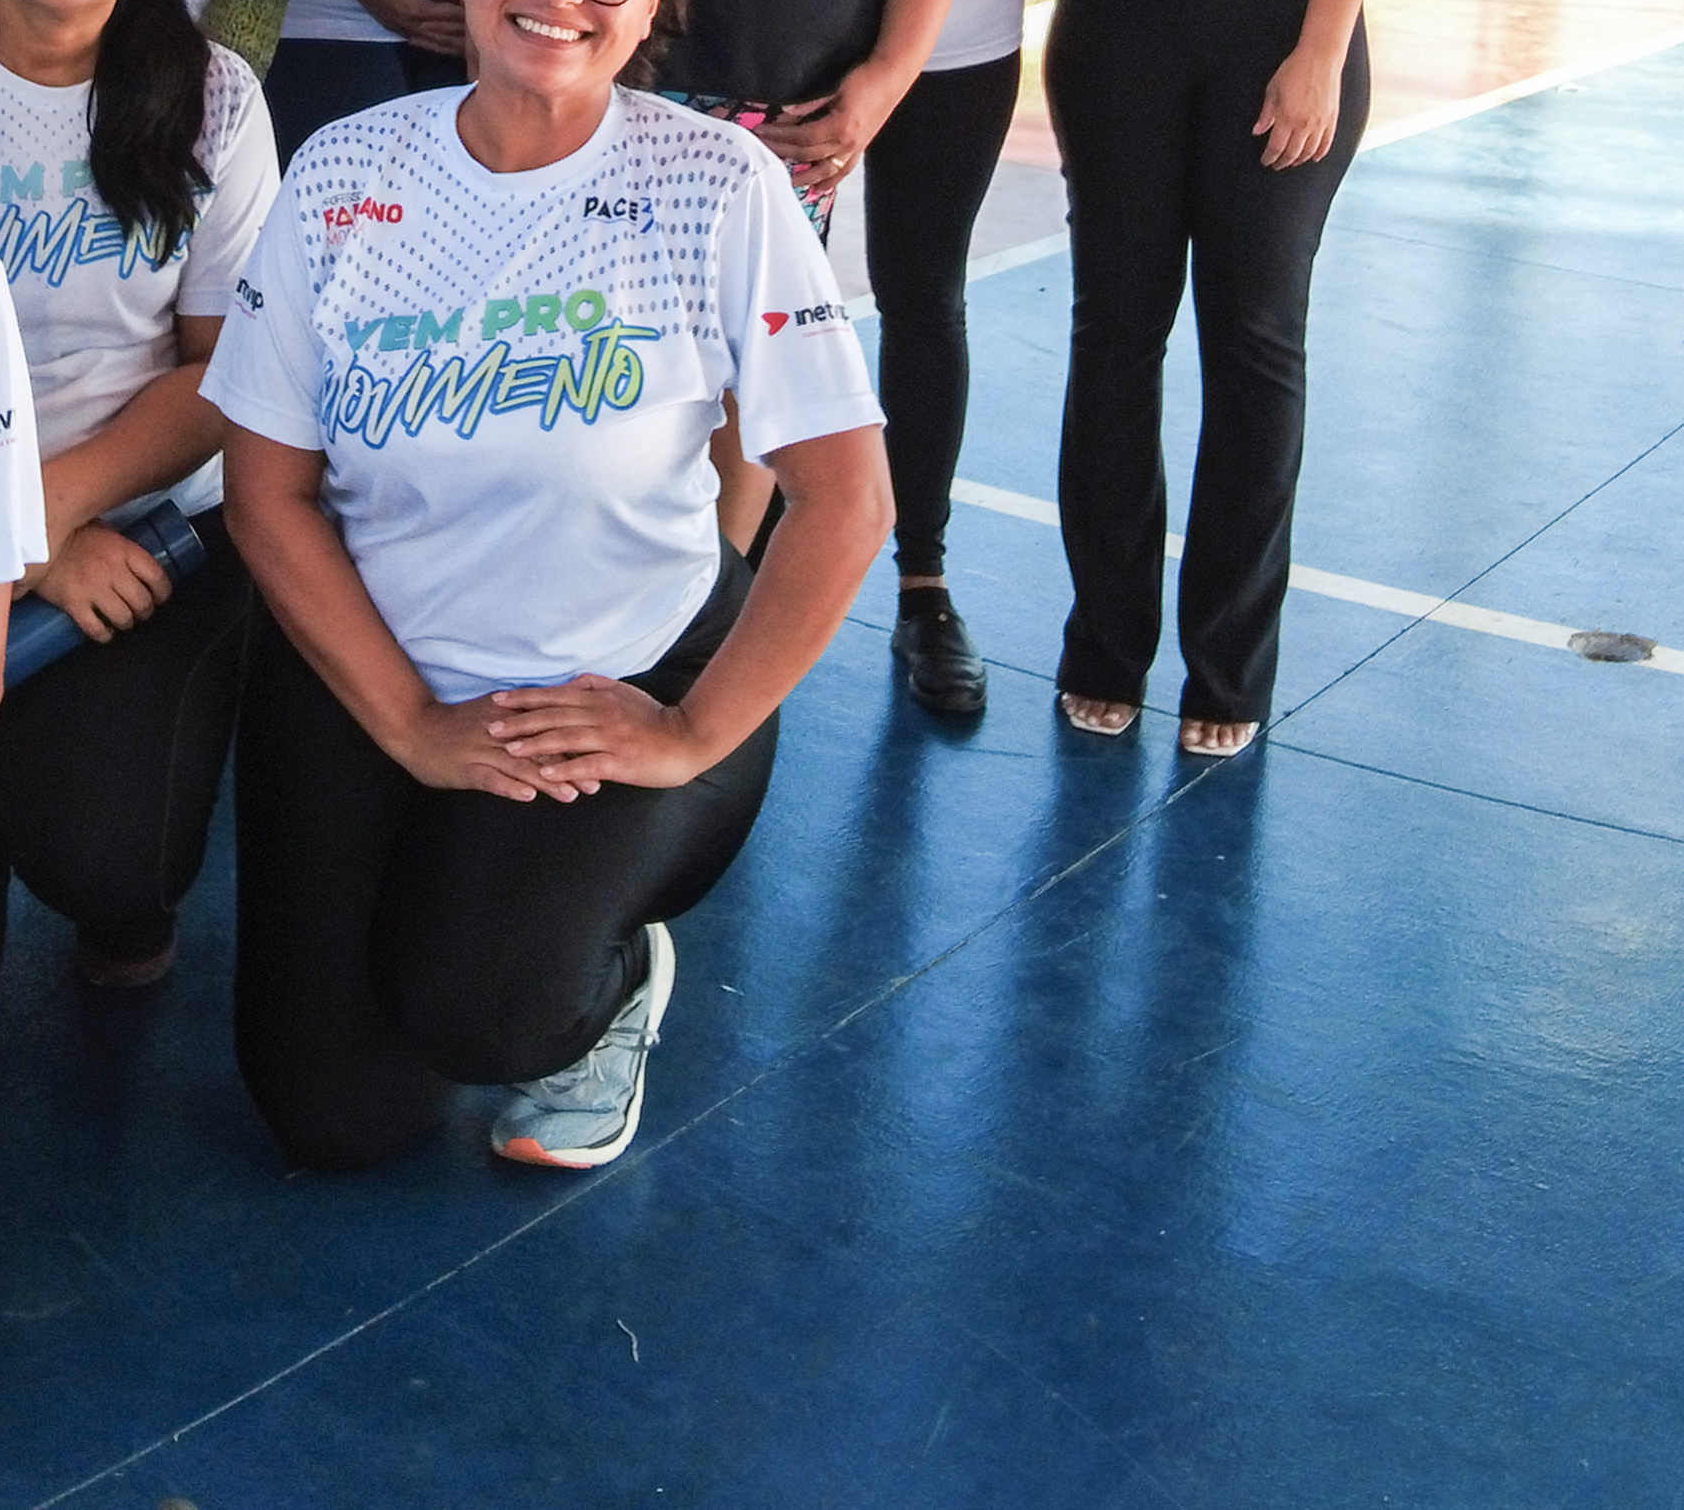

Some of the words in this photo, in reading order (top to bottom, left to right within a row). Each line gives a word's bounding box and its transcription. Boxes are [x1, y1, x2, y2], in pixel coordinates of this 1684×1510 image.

[346, 308, 463, 353] VEM
[482, 289, 607, 341] PRO
[320, 317, 660, 450] MOVIMENTO
